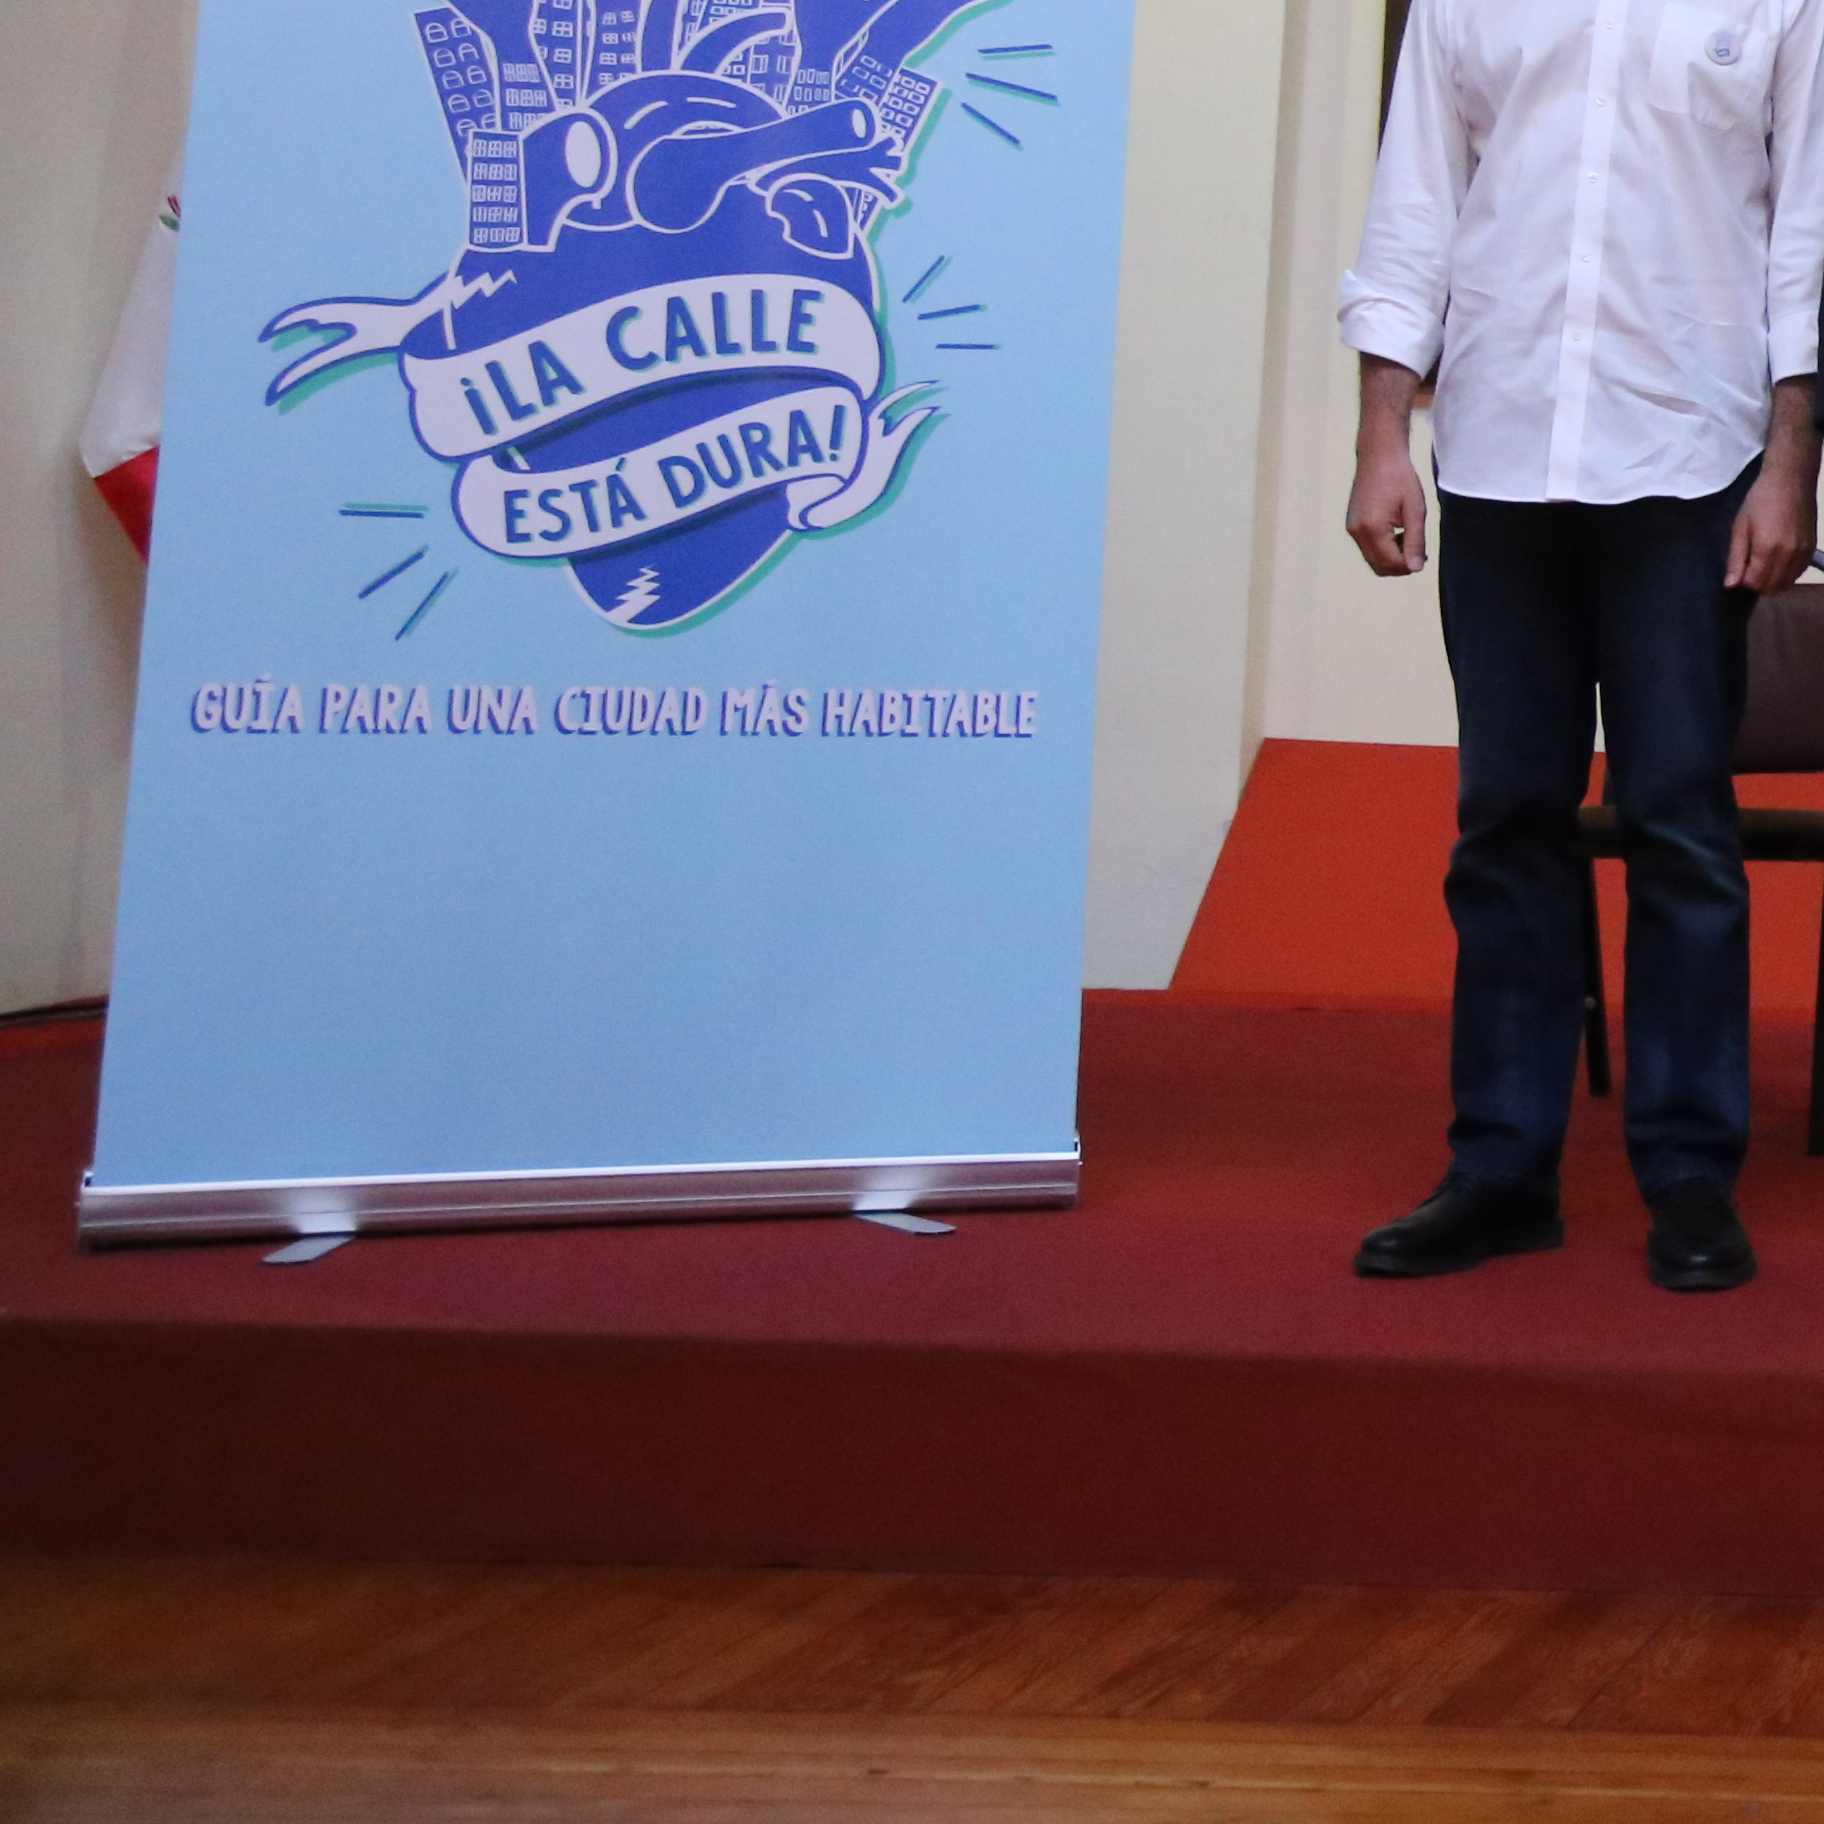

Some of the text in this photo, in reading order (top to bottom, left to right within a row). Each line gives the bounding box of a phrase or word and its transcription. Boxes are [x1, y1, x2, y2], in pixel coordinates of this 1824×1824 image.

[459, 288, 824, 437] ¡LA CALLE
[503, 404, 849, 545] ESTÁ DURA!
[191, 672, 1039, 738] GUÍA PARA UNA CIUDAD MÁS HABITABLE
